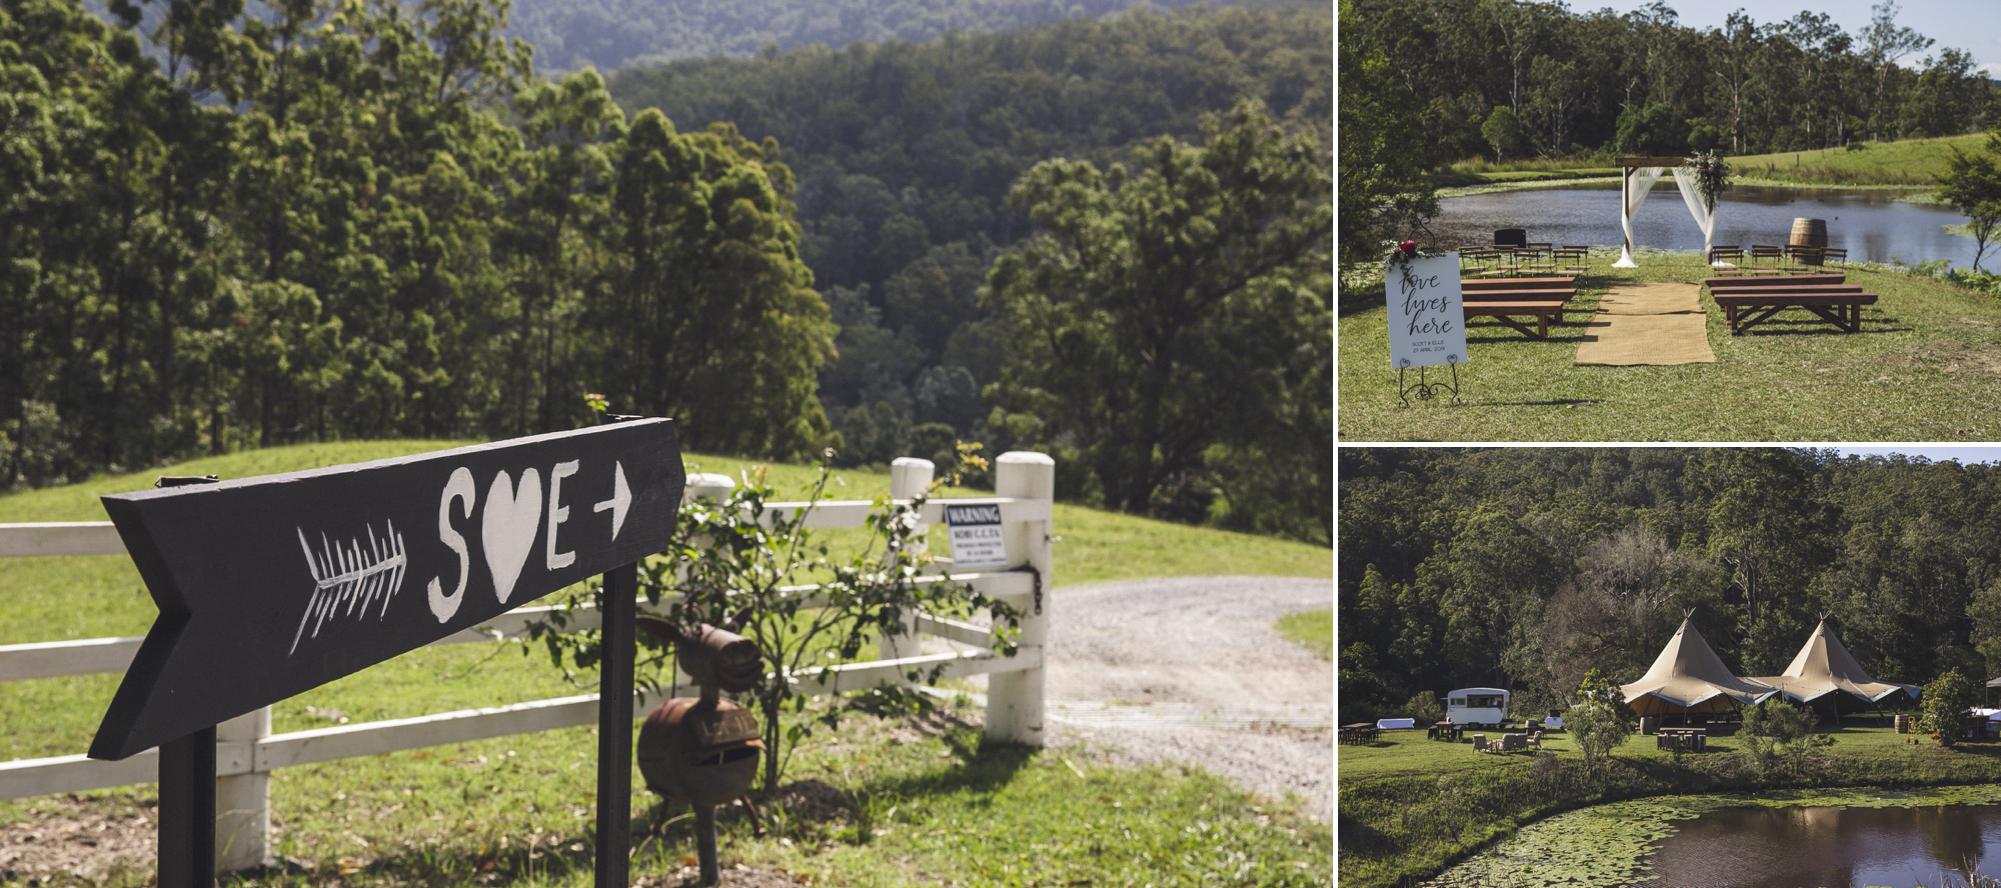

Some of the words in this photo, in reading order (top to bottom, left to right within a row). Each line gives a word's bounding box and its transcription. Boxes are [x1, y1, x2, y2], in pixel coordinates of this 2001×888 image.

[1399, 265, 1440, 295] love
[1401, 288, 1452, 316] lives
[1407, 309, 1453, 336] here
[948, 507, 1000, 523] WARNING
